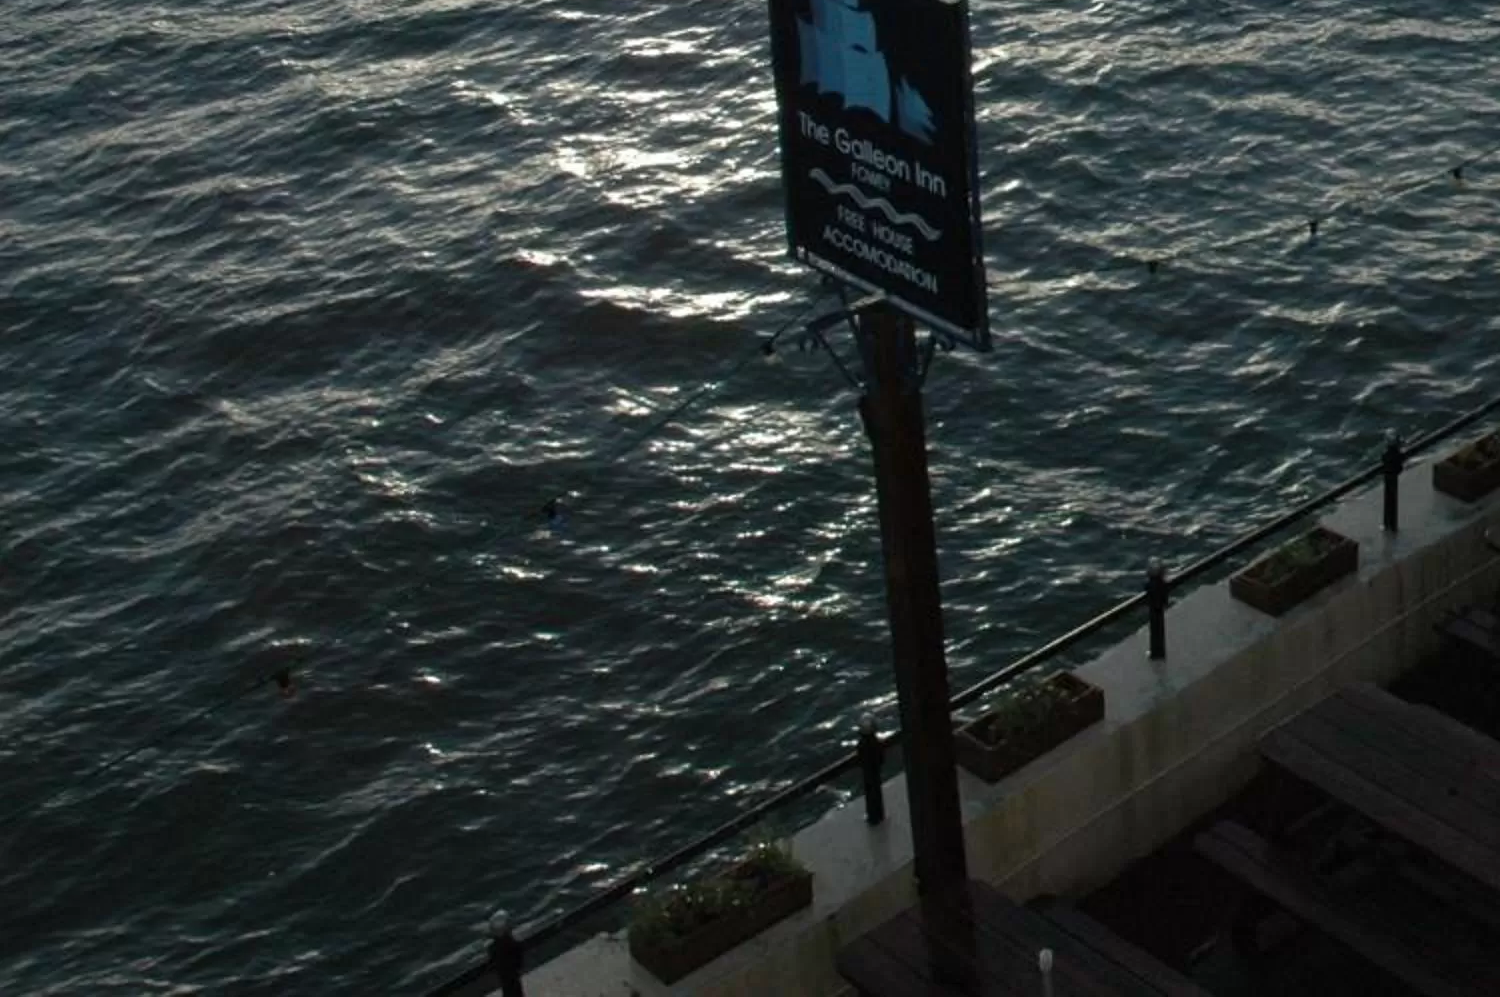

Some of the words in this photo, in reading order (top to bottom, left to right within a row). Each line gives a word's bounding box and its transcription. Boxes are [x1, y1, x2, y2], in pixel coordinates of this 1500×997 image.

[798, 110, 831, 146] The
[834, 127, 912, 183] Galleon
[914, 159, 948, 198] Inn
